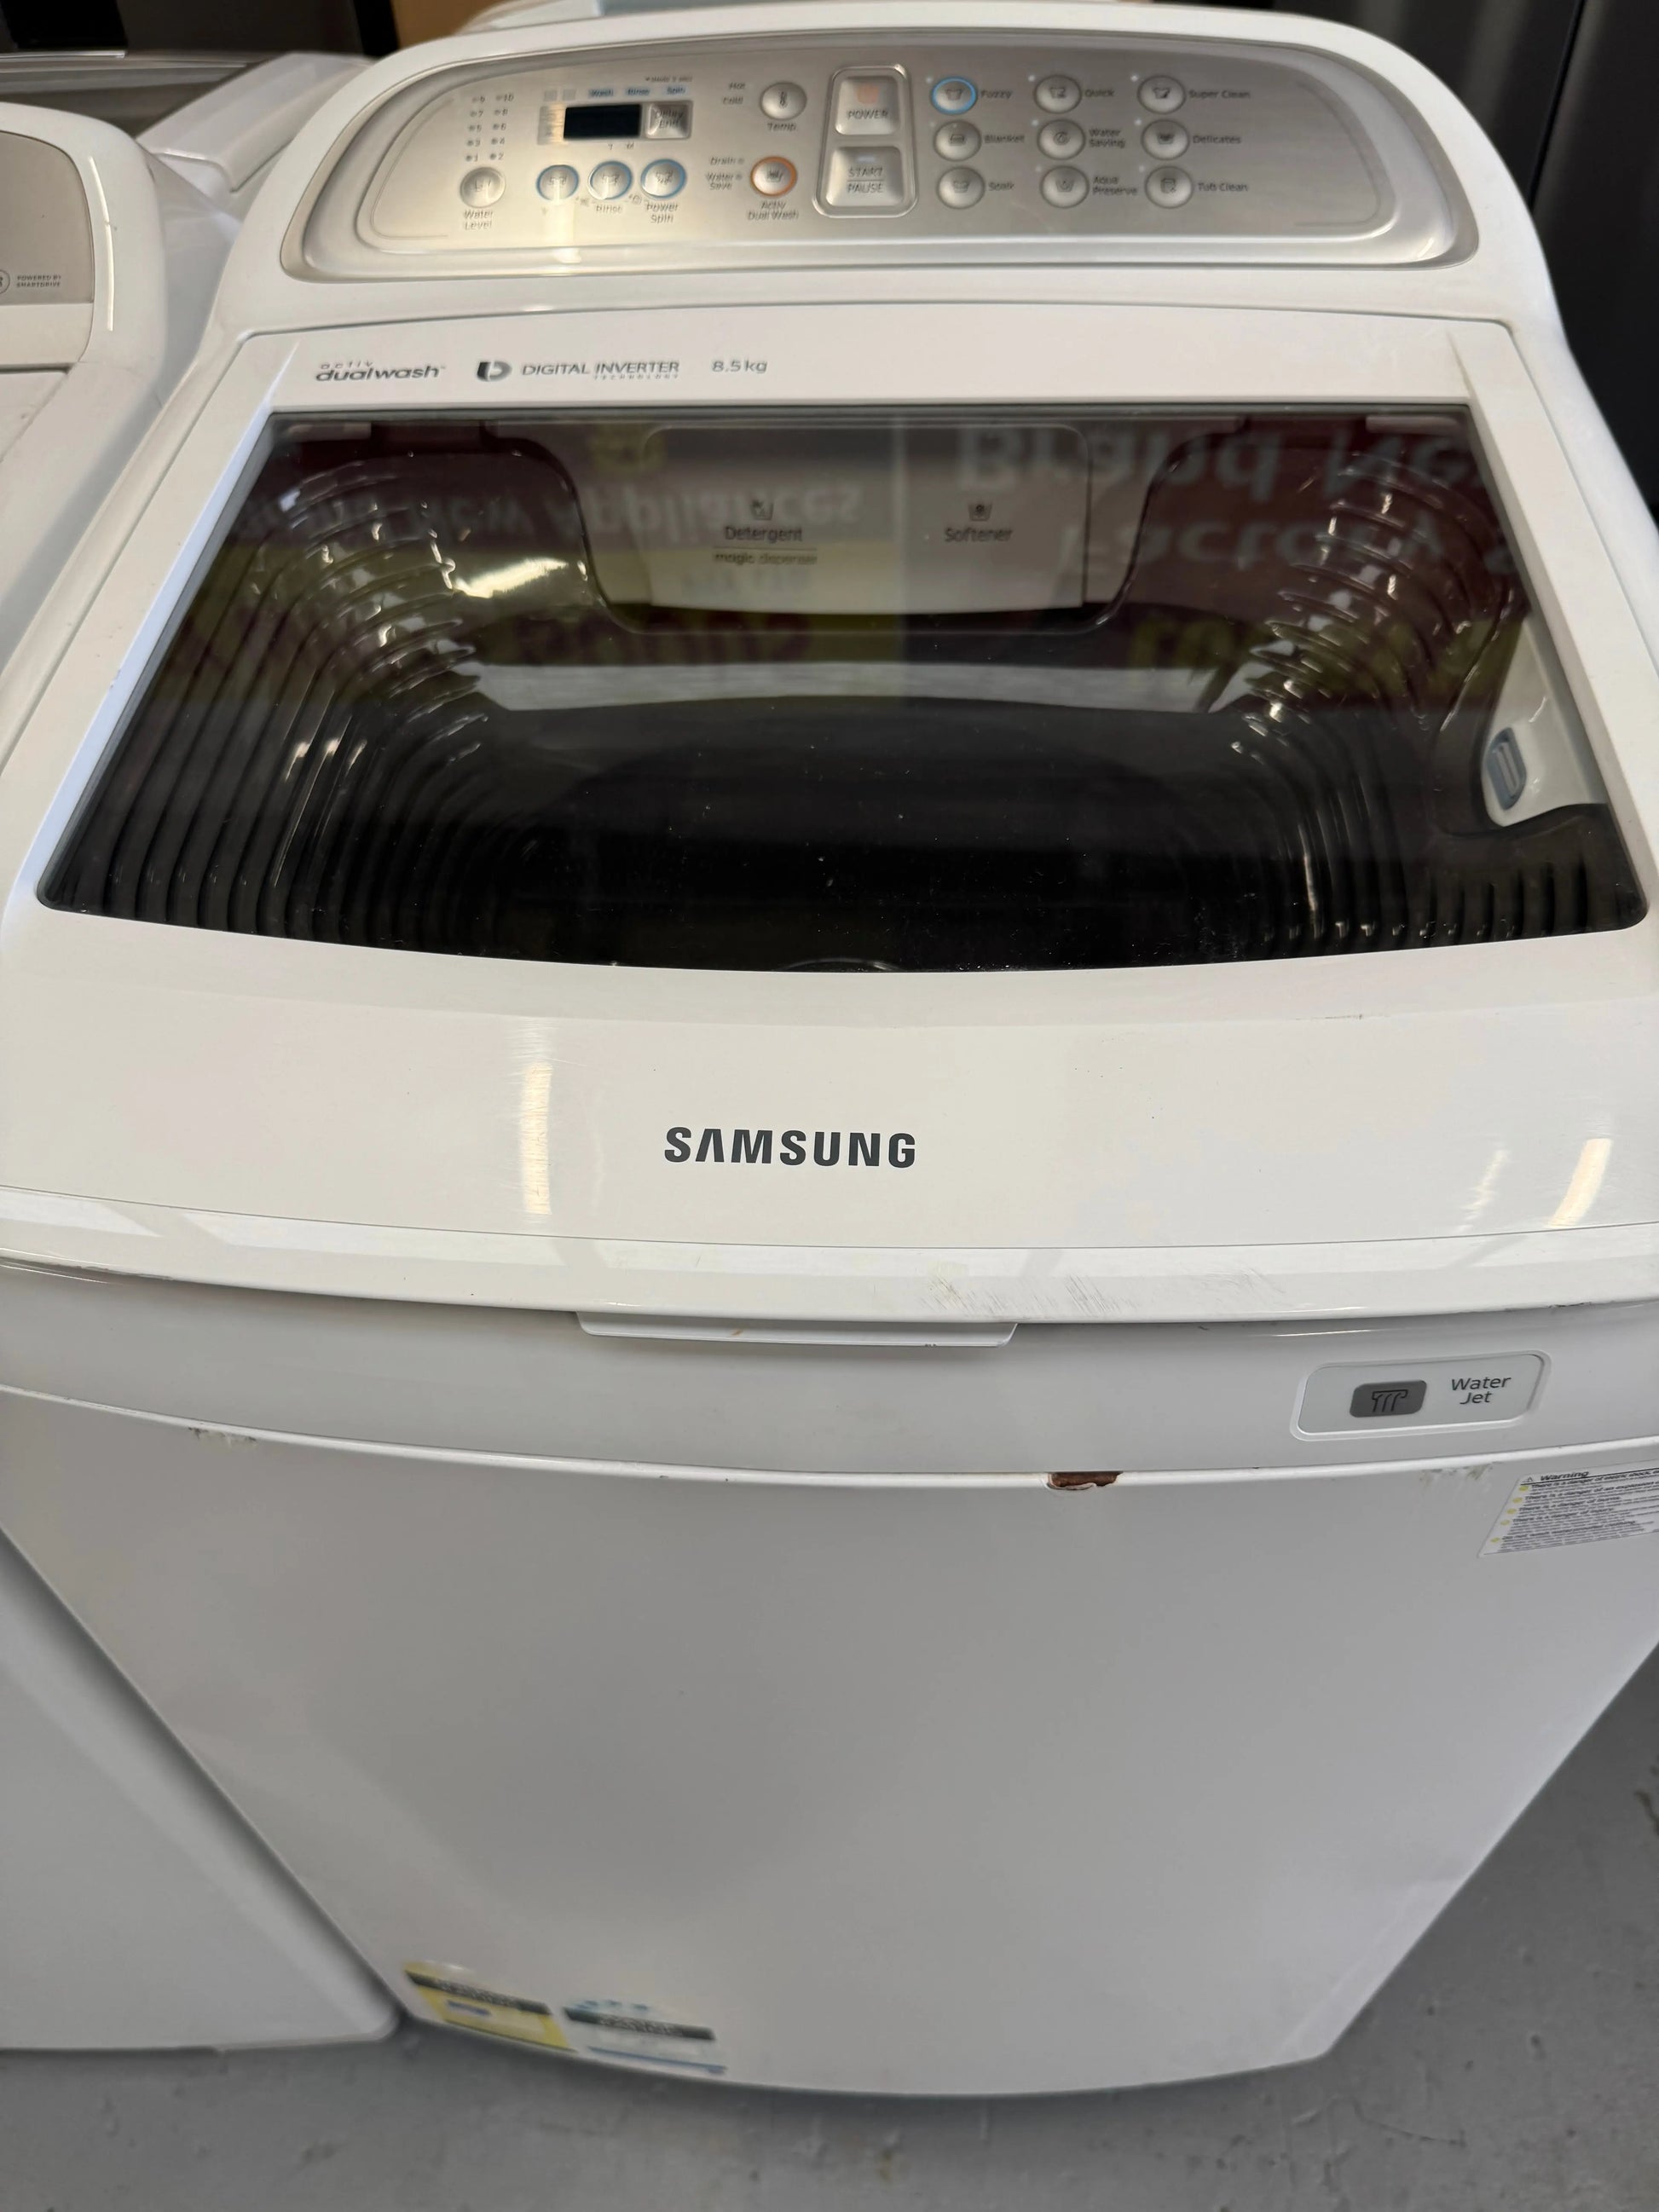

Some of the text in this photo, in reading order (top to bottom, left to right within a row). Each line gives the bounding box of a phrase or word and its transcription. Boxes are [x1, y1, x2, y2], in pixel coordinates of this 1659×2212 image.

[1084, 89, 1114, 97] Quick
[1189, 90, 1218, 100] Super
[847, 110, 887, 119] POWER
[1090, 139, 1125, 148] Saving
[1193, 135, 1241, 144] Delicates
[849, 167, 883, 176] START
[847, 183, 883, 193] PAUSE
[465, 211, 493, 219] Water
[465, 221, 492, 230] Level
[321, 360, 373, 370] activ
[522, 363, 590, 375] DIGITAL
[596, 361, 679, 374] INVERTER
[725, 526, 802, 544] Detergent
[945, 527, 1013, 542] Softener
[664, 1126, 916, 1169] SAMSUNG
[1450, 1376, 1512, 1391] Water
[1460, 1391, 1493, 1405] Jet
[1540, 1471, 1589, 1481] Warning
